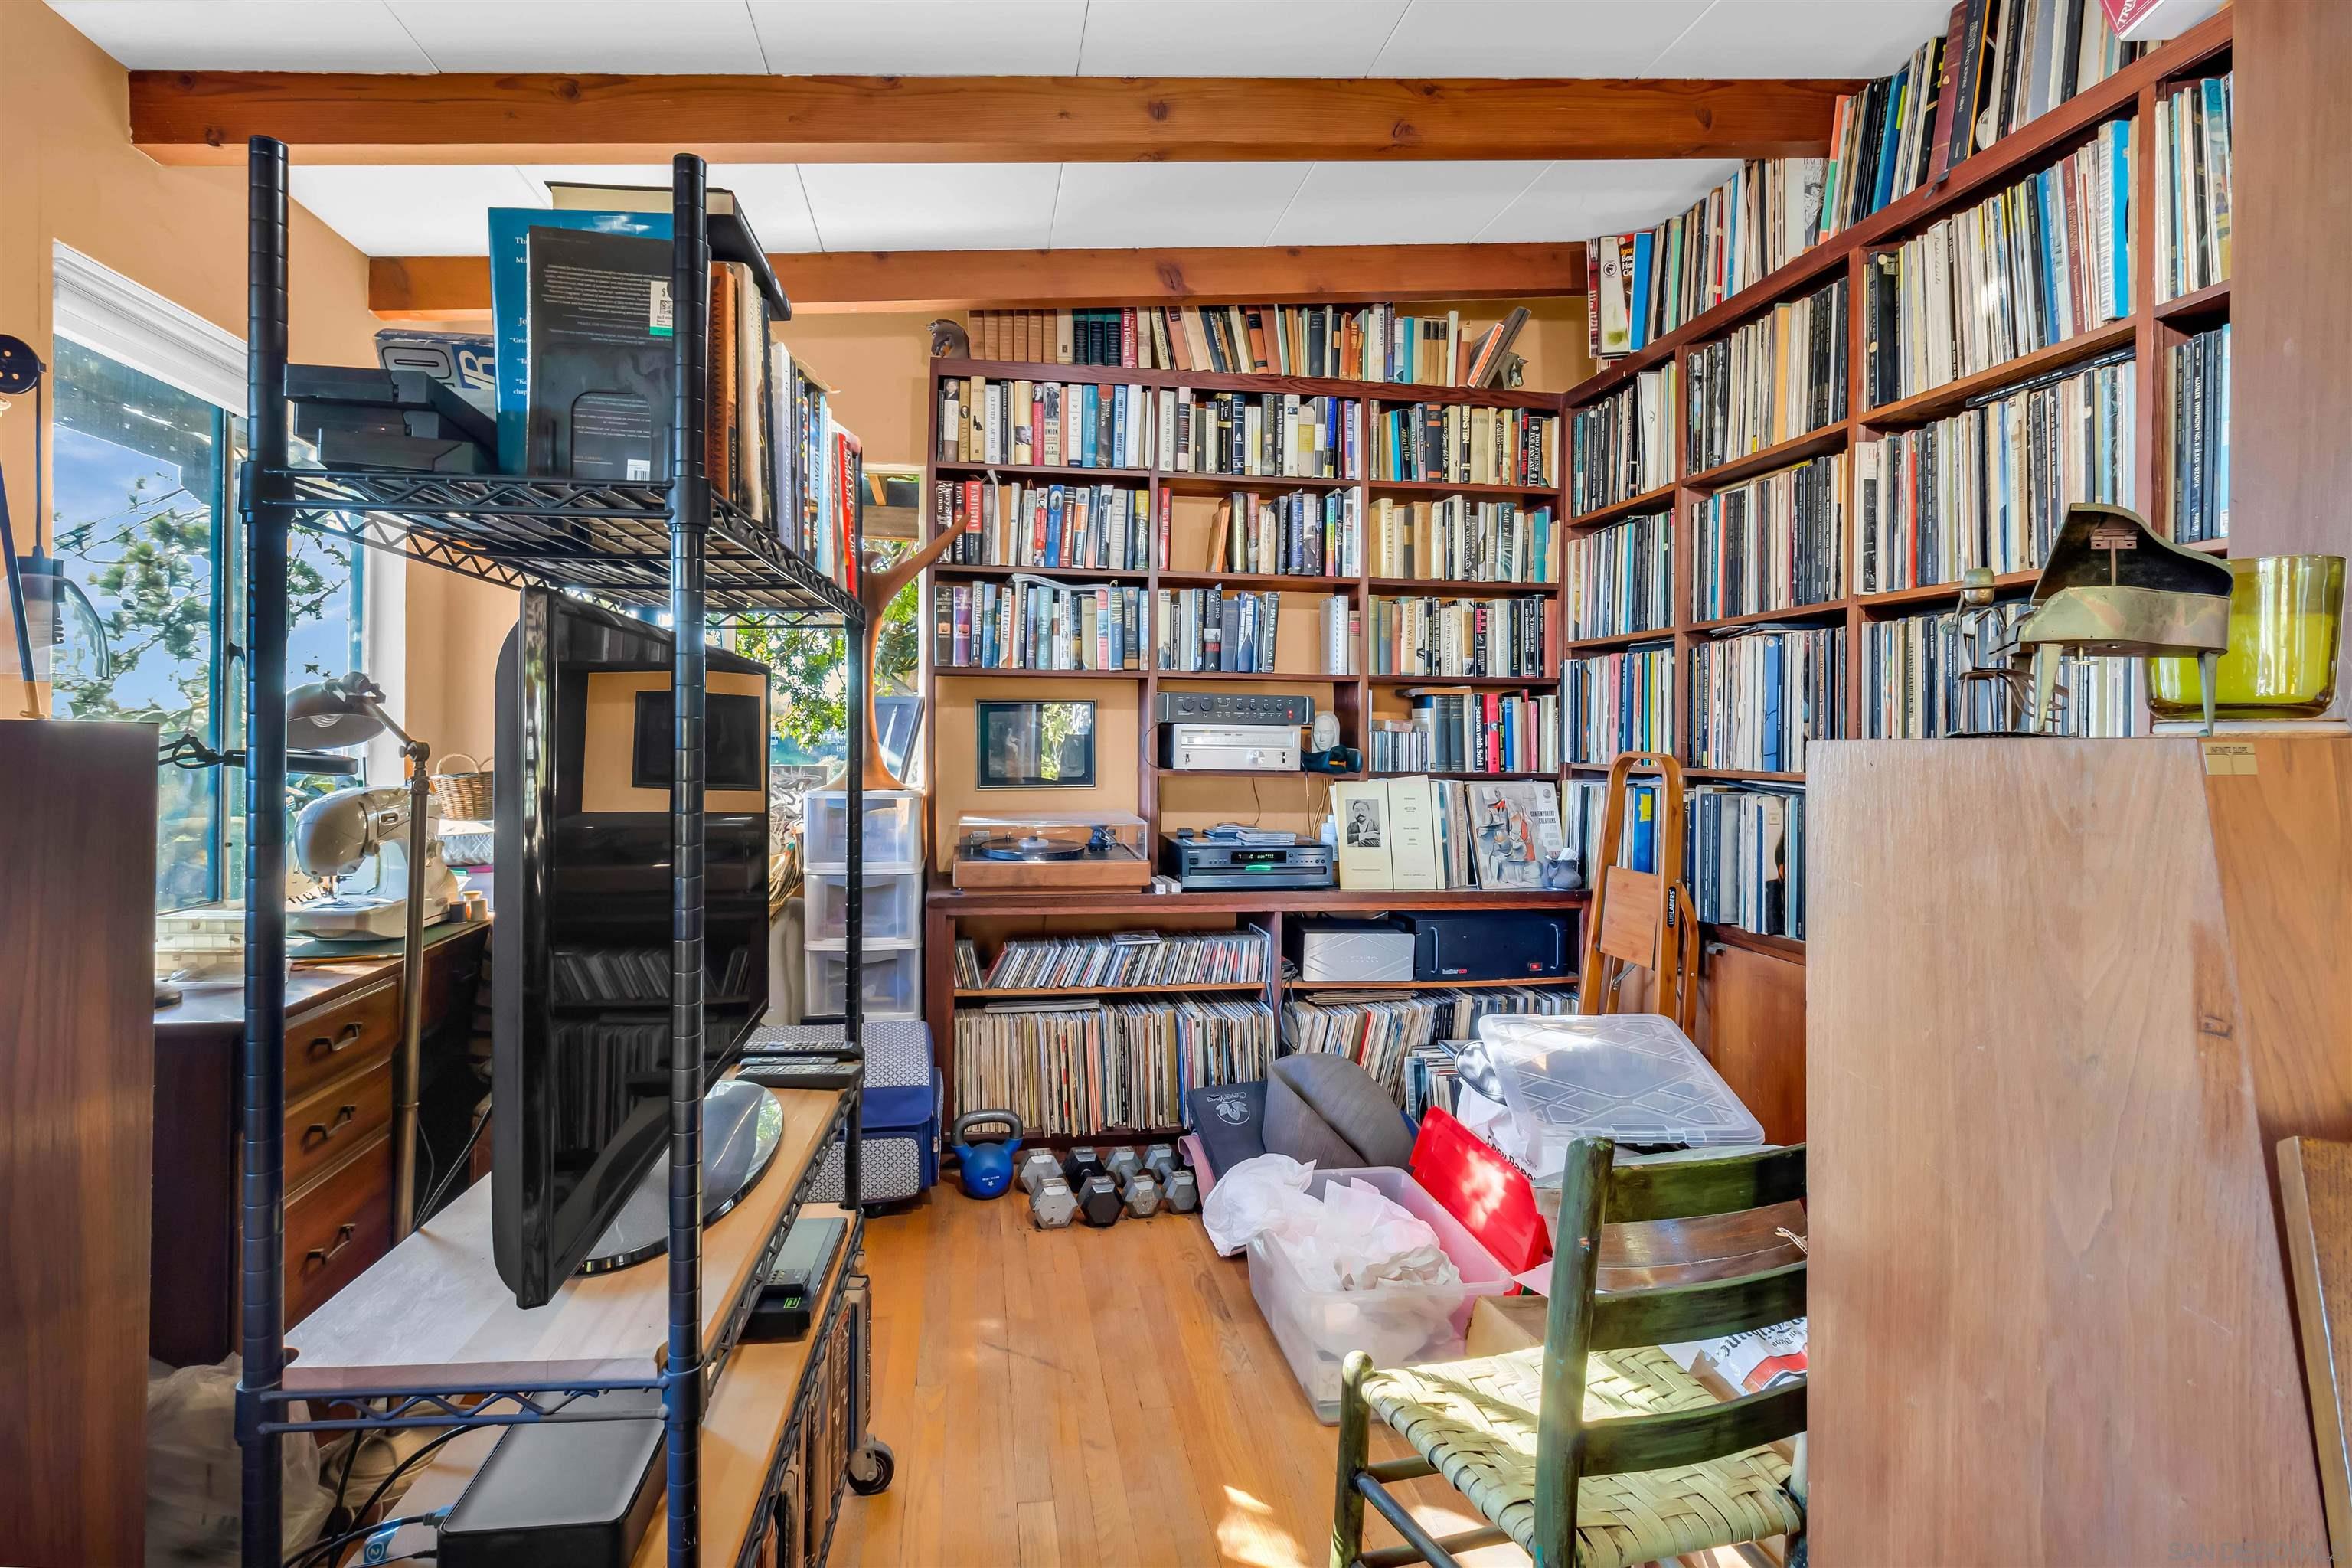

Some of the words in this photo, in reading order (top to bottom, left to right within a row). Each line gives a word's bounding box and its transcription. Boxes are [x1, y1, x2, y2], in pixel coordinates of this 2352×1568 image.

[1158, 330, 1167, 361] Shakespeare
[937, 485, 946, 512] Truman
[970, 485, 979, 527] WASHINGTON
[1111, 590, 1122, 624] SHERIDAN
[1772, 1337, 1793, 1348] Diego
